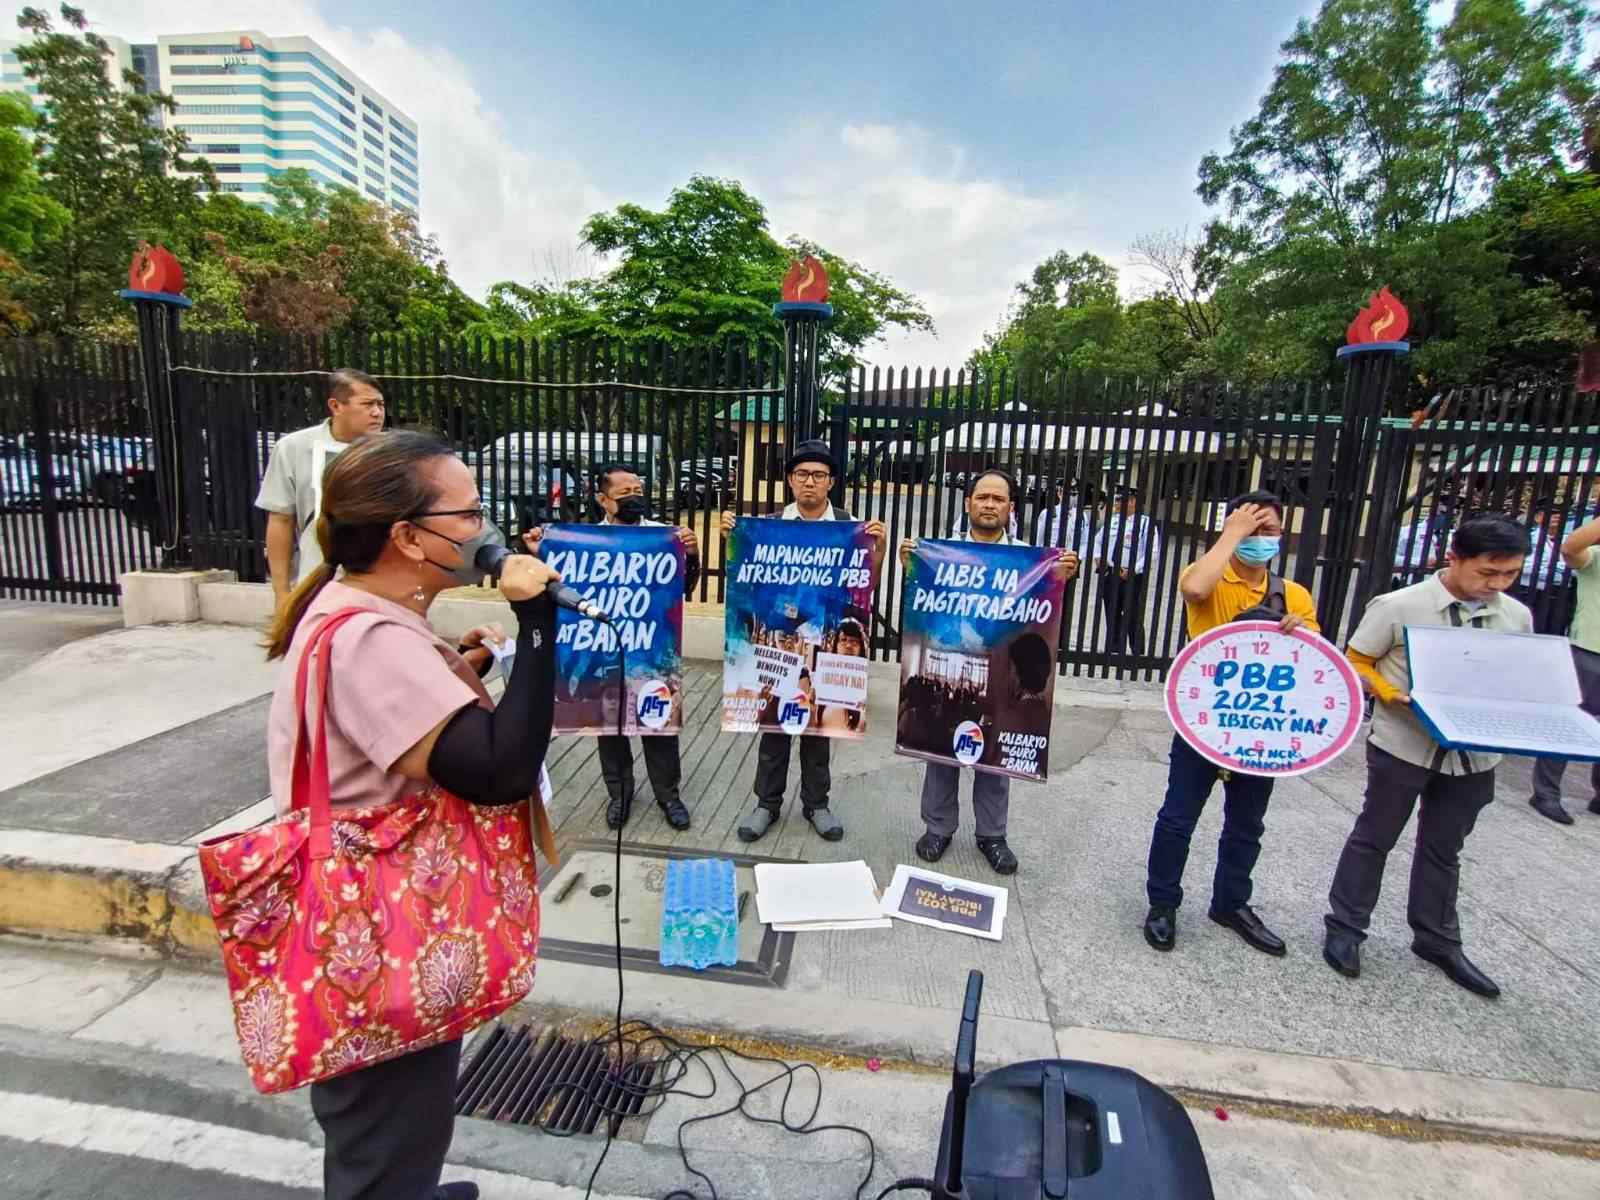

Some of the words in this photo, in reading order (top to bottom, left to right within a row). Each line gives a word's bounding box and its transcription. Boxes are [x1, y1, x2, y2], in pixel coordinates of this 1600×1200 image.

[753, 544, 845, 568] MAPANGHATI
[849, 549, 869, 569] AT
[546, 551, 677, 585] KALBARYO
[736, 563, 833, 587] ATRASADONG
[838, 569, 872, 589] PBB
[934, 562, 987, 588] LABIS
[992, 568, 1019, 592] NA
[912, 588, 1052, 624] PAGTATRABAHO
[556, 624, 578, 644] AT
[572, 619, 656, 652] BAYAN
[754, 647, 782, 660] RELEASE
[782, 653, 798, 666] OUR
[1223, 646, 1238, 659] 11
[1251, 641, 1270, 655] 12
[1291, 651, 1299, 664] 1
[756, 661, 789, 677] BENEFITS
[1200, 664, 1215, 678] 10
[1213, 660, 1296, 691] PBB
[1314, 670, 1324, 684] 2
[639, 695, 669, 718] ACT
[1212, 691, 1297, 715] 2021.
[1324, 696, 1335, 710] 3
[779, 702, 808, 725] ACT
[1197, 712, 1208, 725] 8
[1218, 713, 1284, 732] IBIGAY
[1290, 717, 1328, 735] NA!
[955, 734, 982, 757] ACT
[998, 731, 1047, 749] KALBARYO
[1223, 732, 1231, 745] 7
[1009, 745, 1037, 760] GURO
[1235, 746, 1265, 760] ACT
[1006, 757, 1038, 773] BAYAN
[939, 894, 982, 911] IBIGAY
[951, 905, 977, 917] PBB
